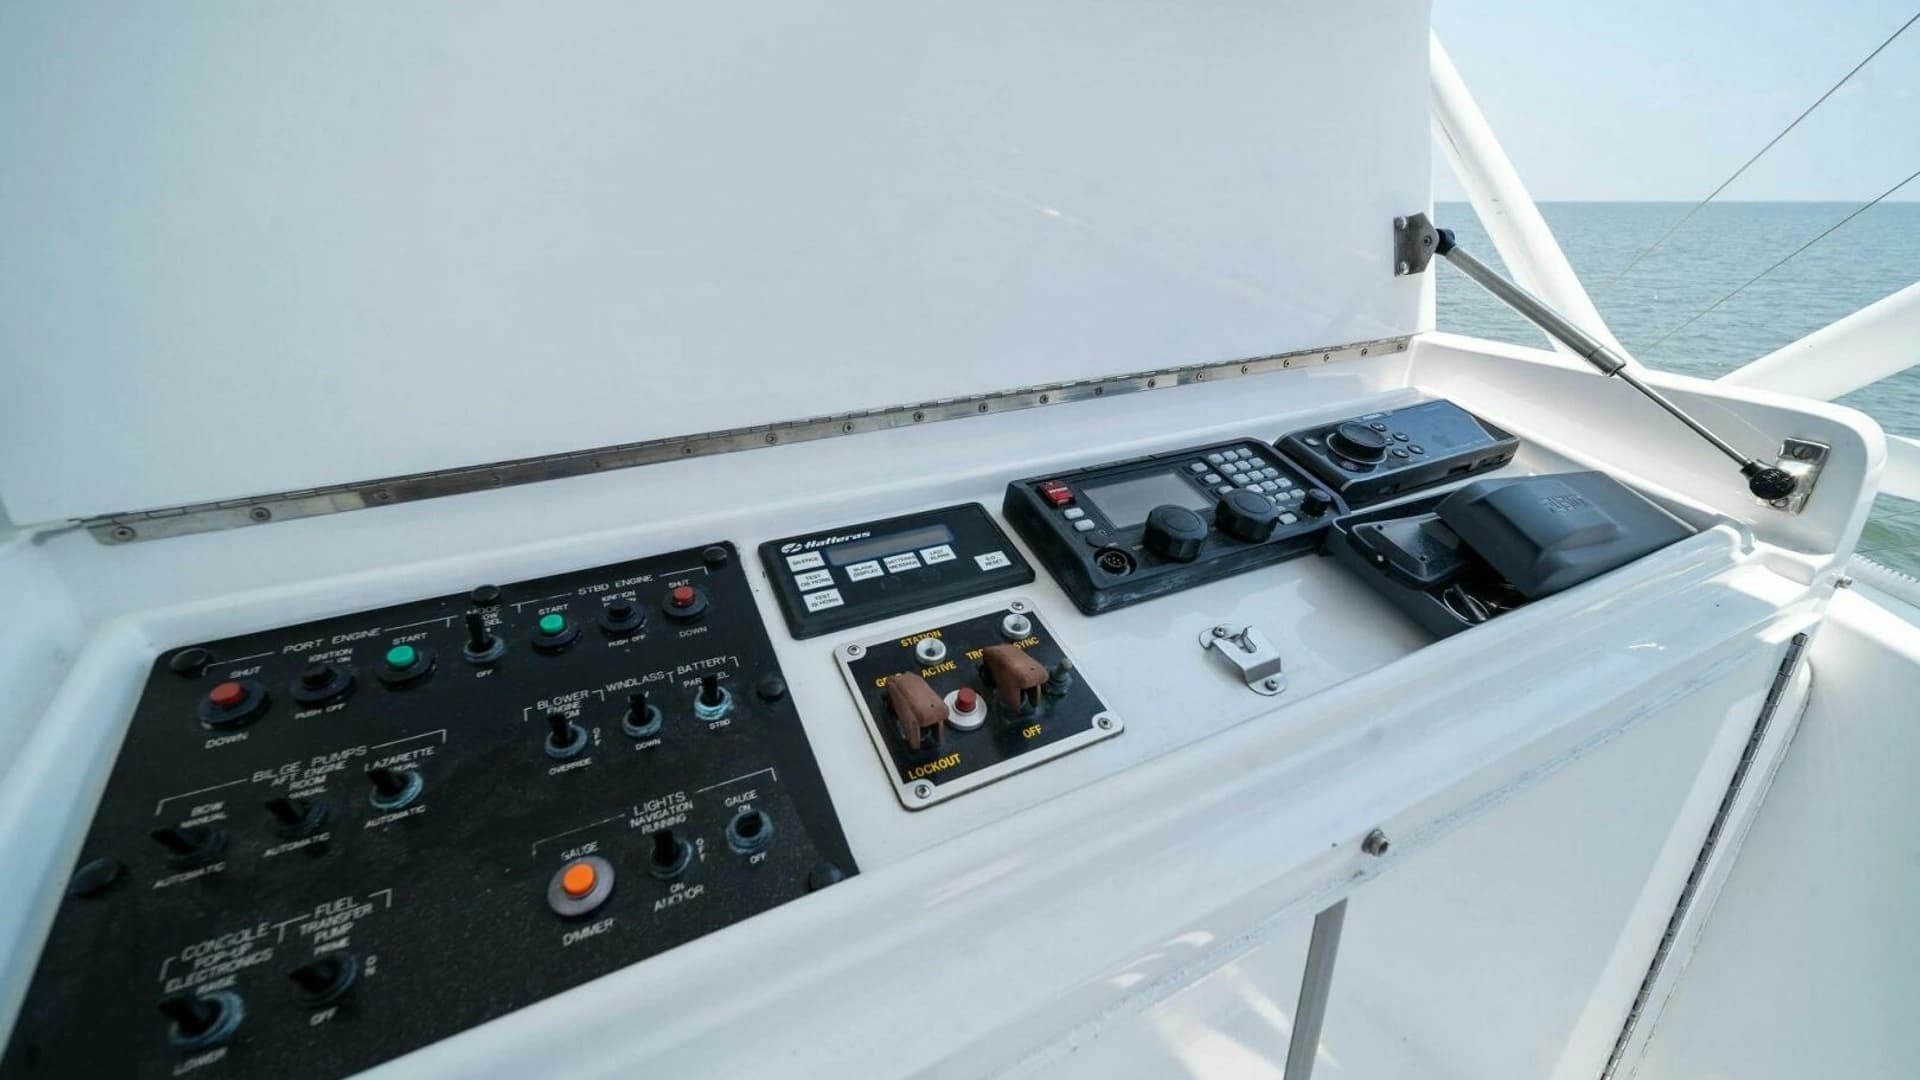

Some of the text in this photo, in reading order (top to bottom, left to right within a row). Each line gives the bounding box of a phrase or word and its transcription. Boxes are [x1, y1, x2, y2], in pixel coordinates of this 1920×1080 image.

[804, 531, 871, 549] Hatteras
[578, 574, 654, 596] STBD ENGINE
[668, 579, 690, 589] SHUT
[538, 603, 569, 615] START
[282, 627, 382, 654] PORT ENGINE
[392, 632, 428, 645] START
[679, 626, 707, 638] DOWN
[900, 630, 942, 647] STATION
[1013, 636, 1040, 649] SYNC
[308, 648, 354, 662] IGNITION
[230, 665, 263, 679] SHUT
[476, 669, 494, 678] OFF
[677, 656, 728, 675] BATTERY
[921, 660, 957, 678] ACTIVE
[605, 671, 665, 692] WINDLASS
[682, 671, 730, 688] PAREL
[326, 703, 346, 713] OFF
[537, 689, 590, 711] BLOWER
[204, 731, 249, 749] DOWN
[1022, 724, 1042, 739] OFF
[635, 738, 661, 751] DOWN
[252, 745, 368, 783] BILGE PUMPS
[364, 745, 435, 772] LAZARETTE
[548, 757, 592, 776] OVERRIDE
[908, 753, 962, 780] LOCKOUT
[303, 760, 347, 779] ENGINE
[289, 775, 327, 791] ROOM
[634, 791, 687, 816] LIGHTS
[725, 789, 758, 807] GAUGE
[364, 804, 426, 829] AUTOMATIC
[629, 800, 694, 829] NAVIGATION
[641, 813, 687, 835] RUNNING
[264, 832, 331, 857] AUTOMATIC
[560, 841, 600, 861] GAUGE
[749, 851, 767, 864] OFF
[314, 896, 359, 919] FUEL
[654, 884, 705, 912] ANCHOR
[300, 902, 373, 936] TRANSFER
[314, 921, 354, 944] PUMP
[562, 917, 615, 947] DIMMER
[181, 922, 271, 962] CONSOLE
[165, 947, 275, 994] ELECTRONICS
[310, 1006, 338, 1026] OFF
